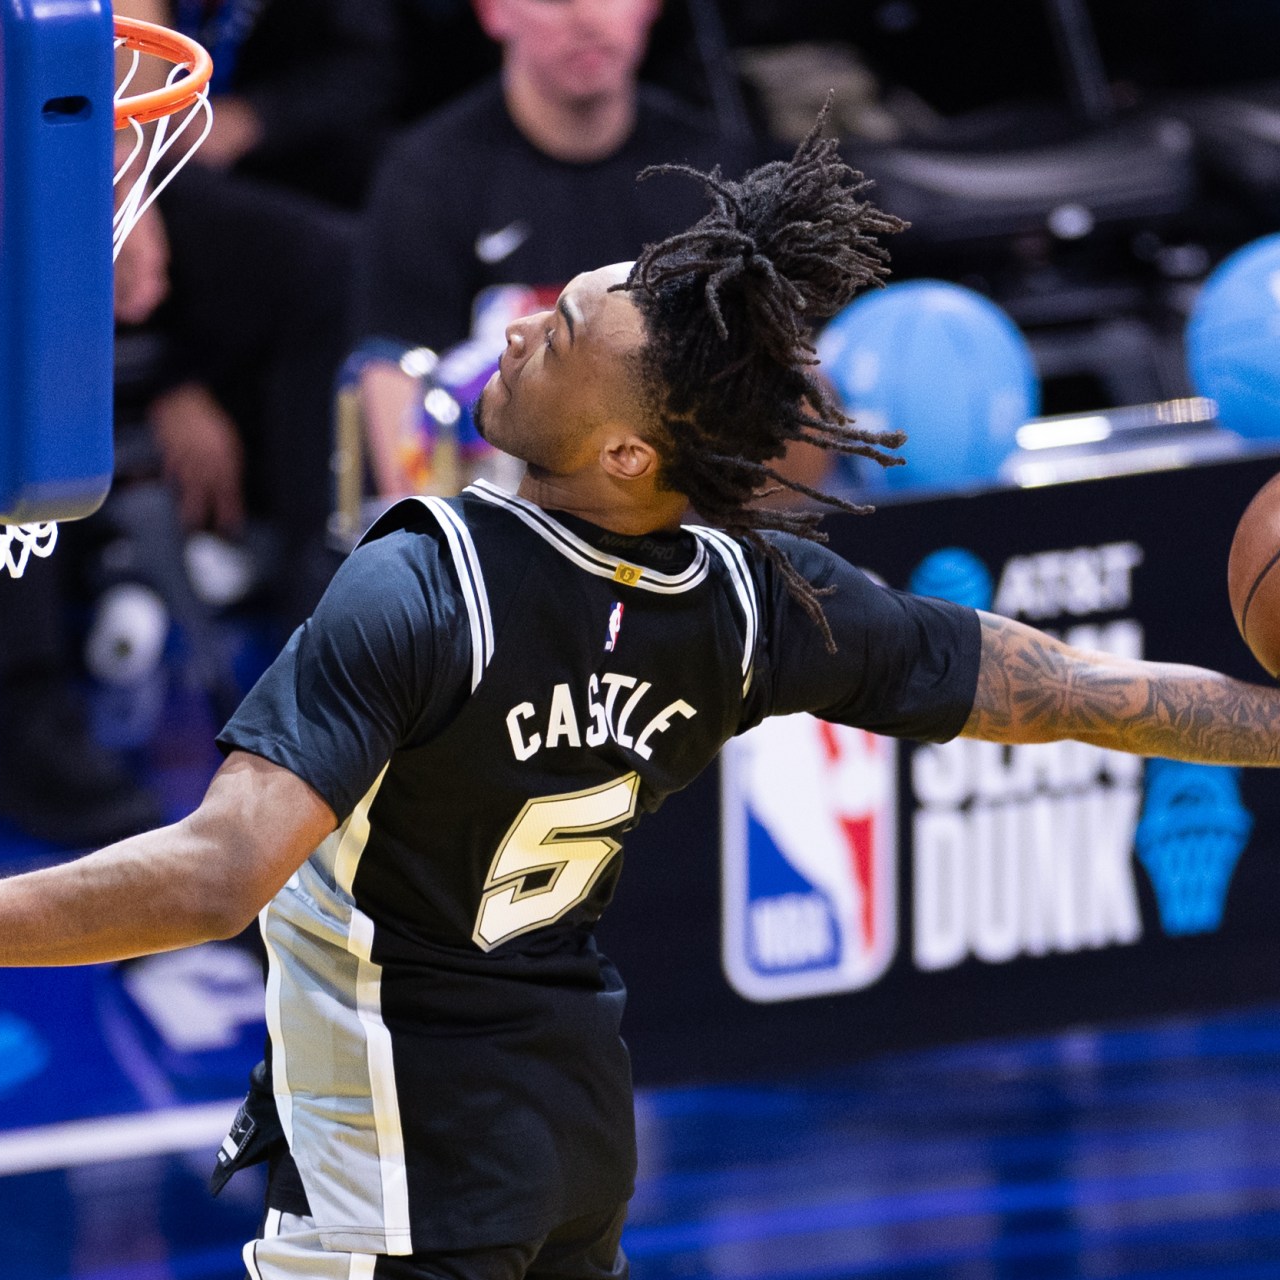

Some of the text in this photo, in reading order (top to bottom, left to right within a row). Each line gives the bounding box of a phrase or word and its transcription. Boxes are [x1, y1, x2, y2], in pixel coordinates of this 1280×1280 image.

[640, 541, 676, 560] PRO
[995, 541, 1144, 620] AT&T
[506, 673, 697, 761] CASTLE
[472, 770, 641, 953] 5
[912, 793, 1143, 972] DUNK
